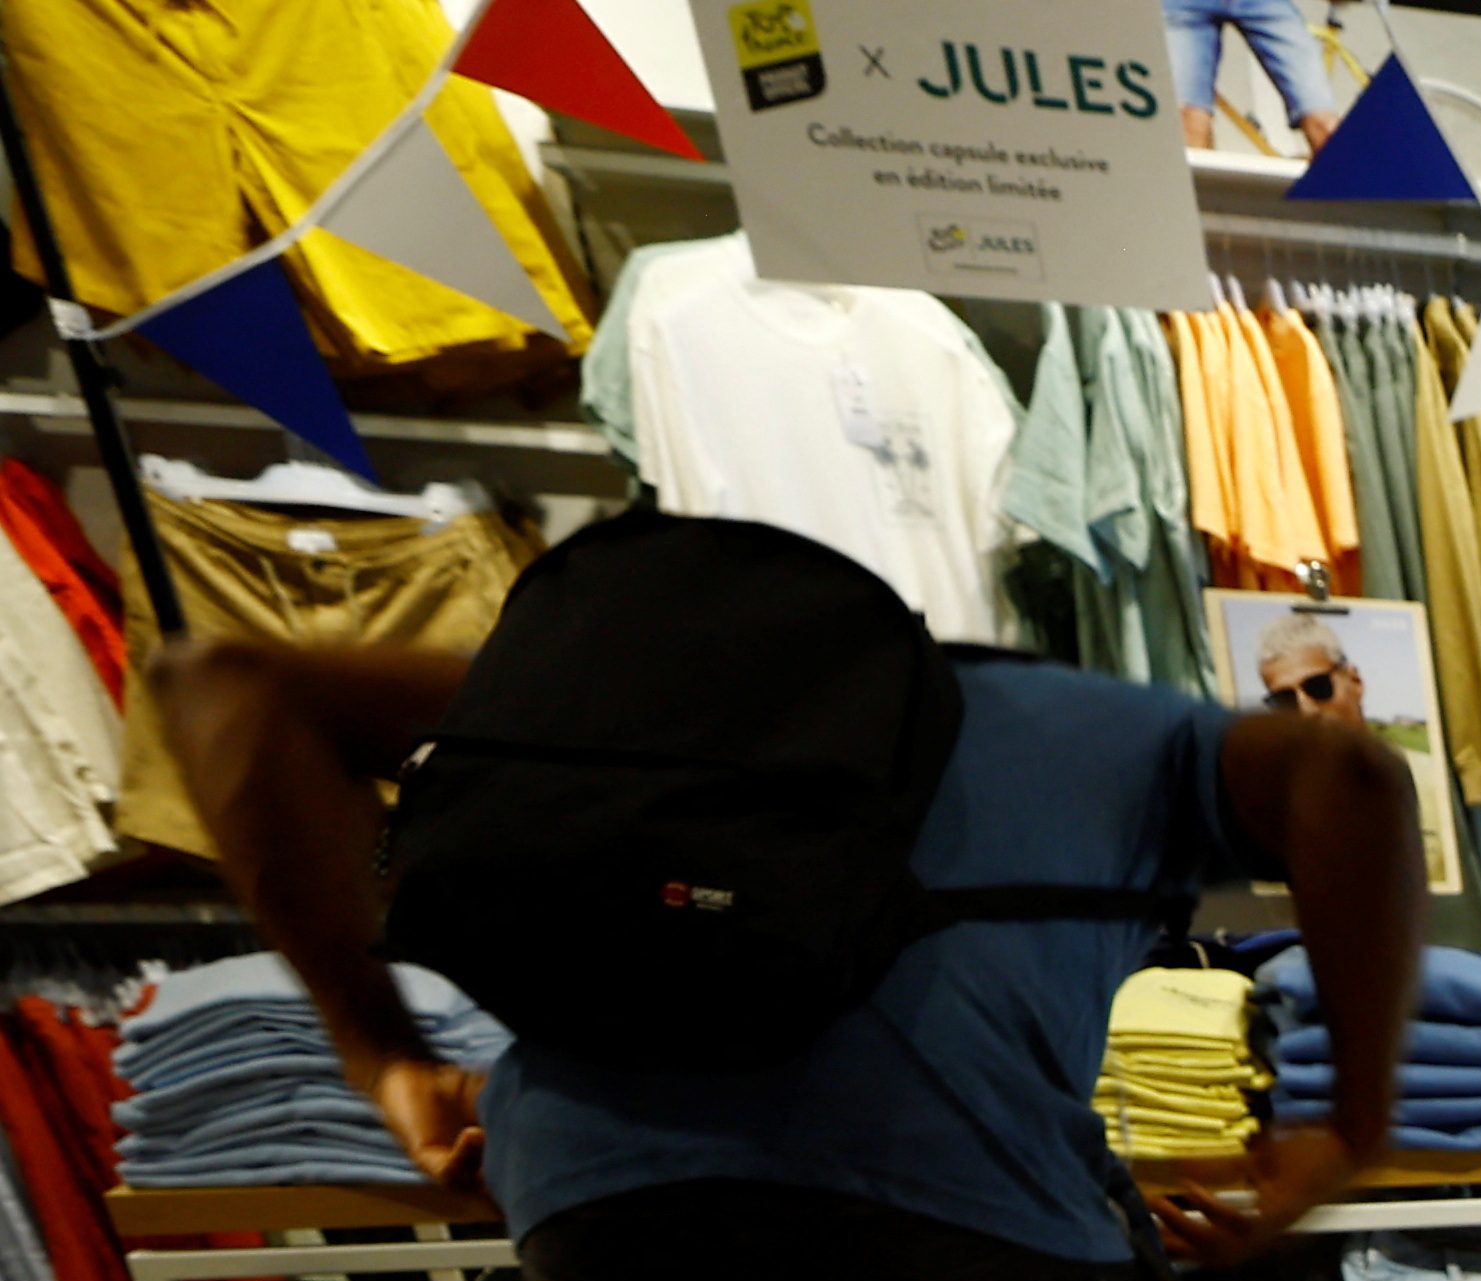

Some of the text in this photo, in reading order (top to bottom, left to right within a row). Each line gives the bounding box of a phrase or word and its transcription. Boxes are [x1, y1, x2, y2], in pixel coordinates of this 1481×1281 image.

[918, 40, 1158, 119] JULES
[807, 122, 1109, 172] Collection capsule exclusive
[873, 167, 1062, 200] en édition limitée
